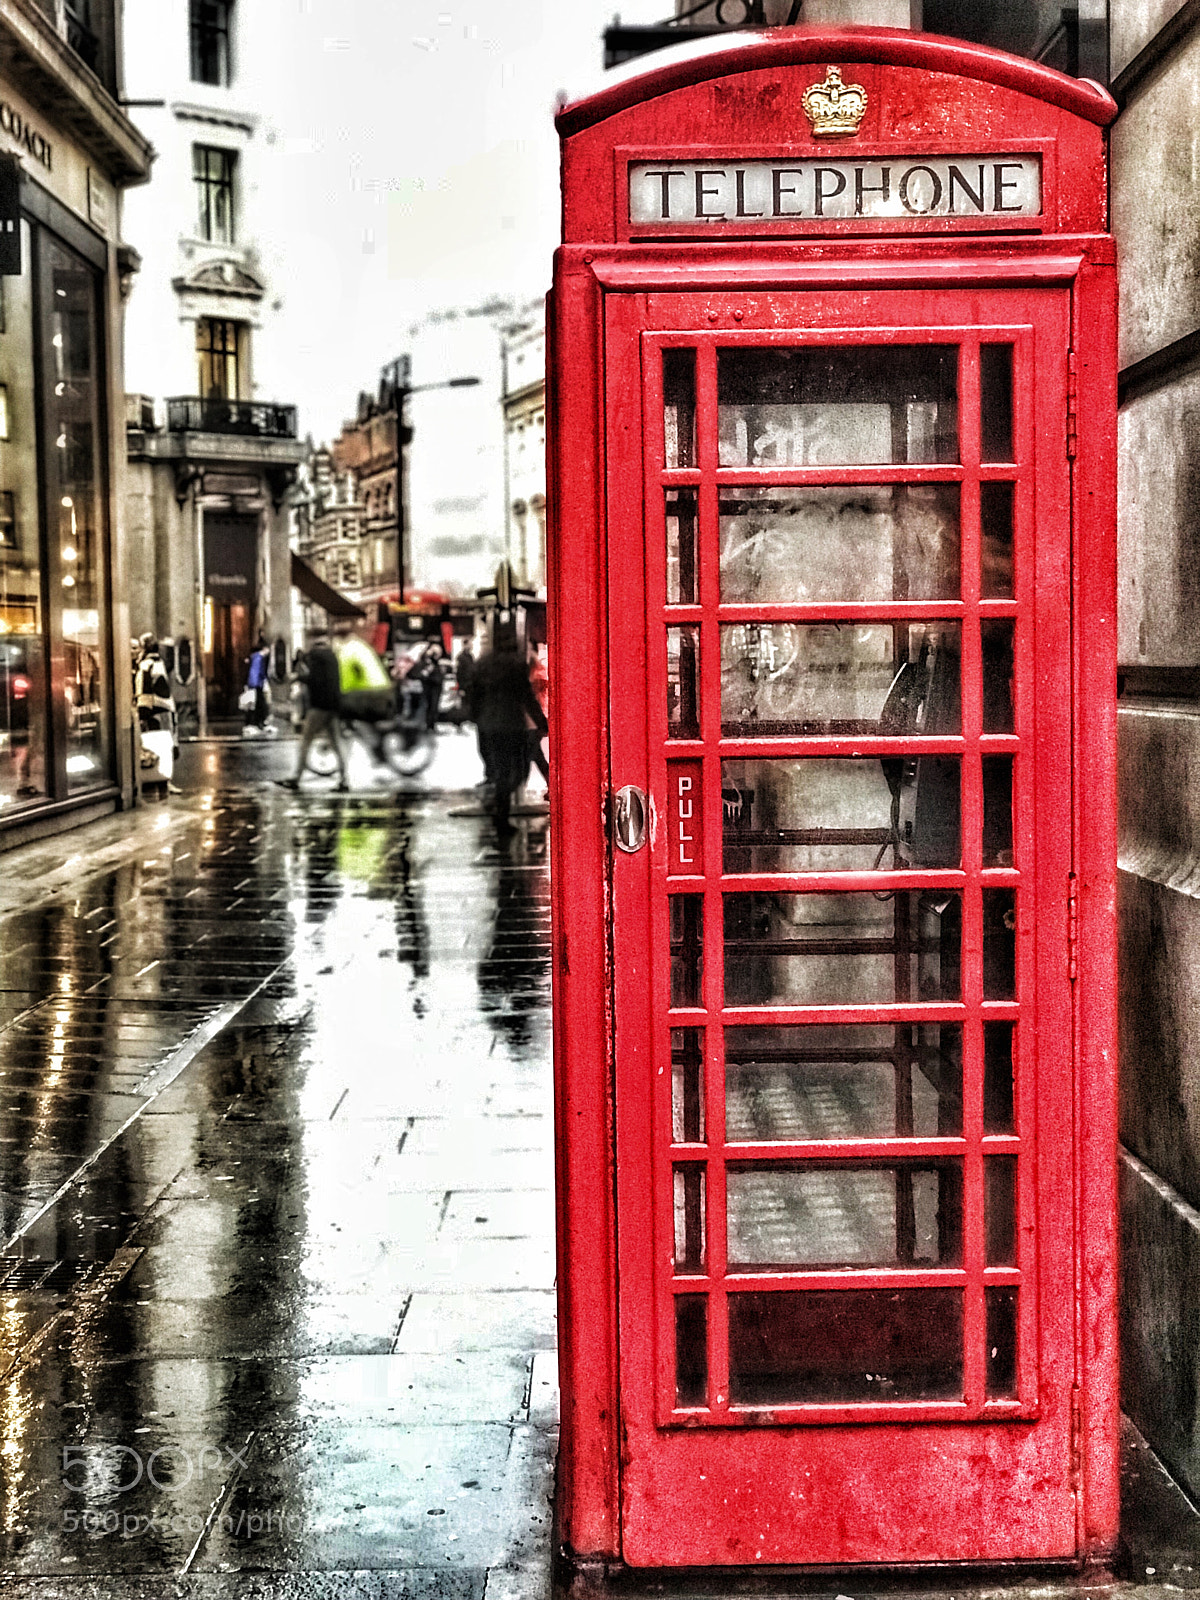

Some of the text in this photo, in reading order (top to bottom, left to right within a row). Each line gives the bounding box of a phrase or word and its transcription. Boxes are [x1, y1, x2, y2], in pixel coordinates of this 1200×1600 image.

[0, 101, 52, 172] COACH
[644, 163, 1024, 218] TELEPHONE
[678, 776, 694, 863] PULL
